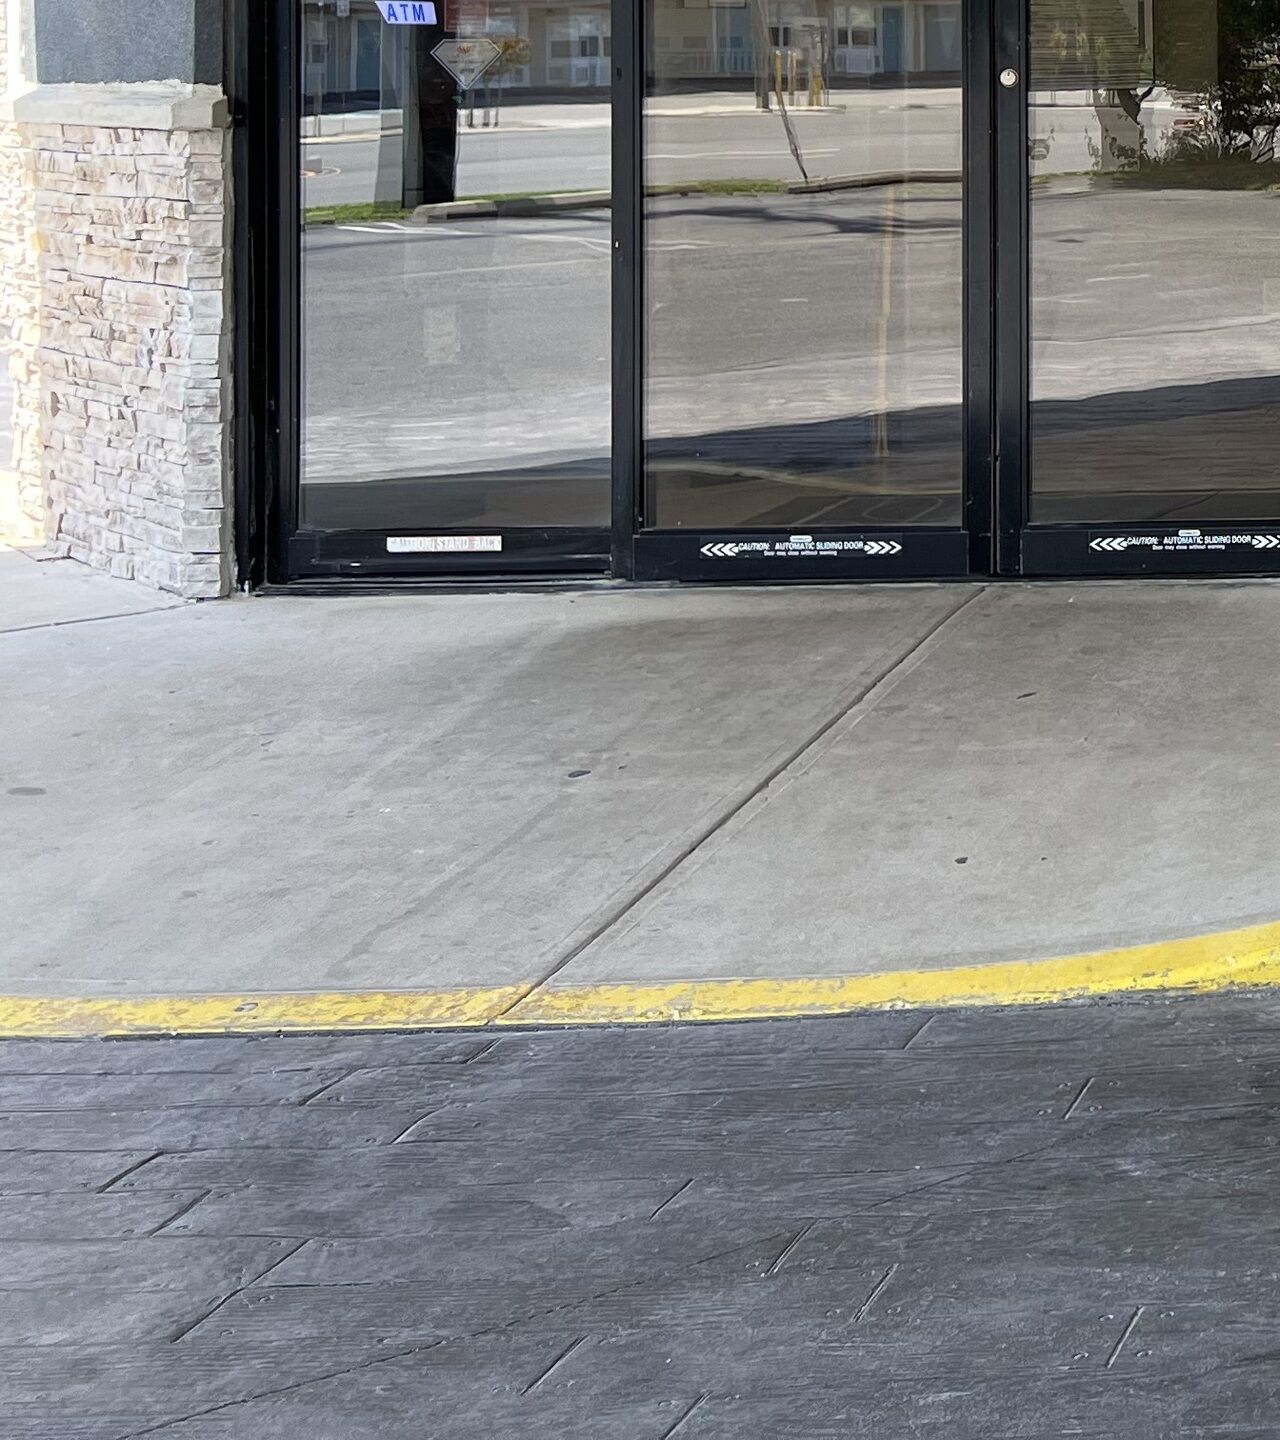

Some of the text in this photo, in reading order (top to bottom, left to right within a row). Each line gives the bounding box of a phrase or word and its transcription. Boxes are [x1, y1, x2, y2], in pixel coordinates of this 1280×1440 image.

[386, 3, 426, 23] ATM
[1163, 536, 1203, 545] AUTOMATIC
[1204, 536, 1231, 544] SLIDING
[1232, 535, 1252, 544] DOOR
[774, 541, 816, 550] AUTOMATIC
[816, 541, 843, 550] SLIDING
[844, 541, 864, 549] DOOR
